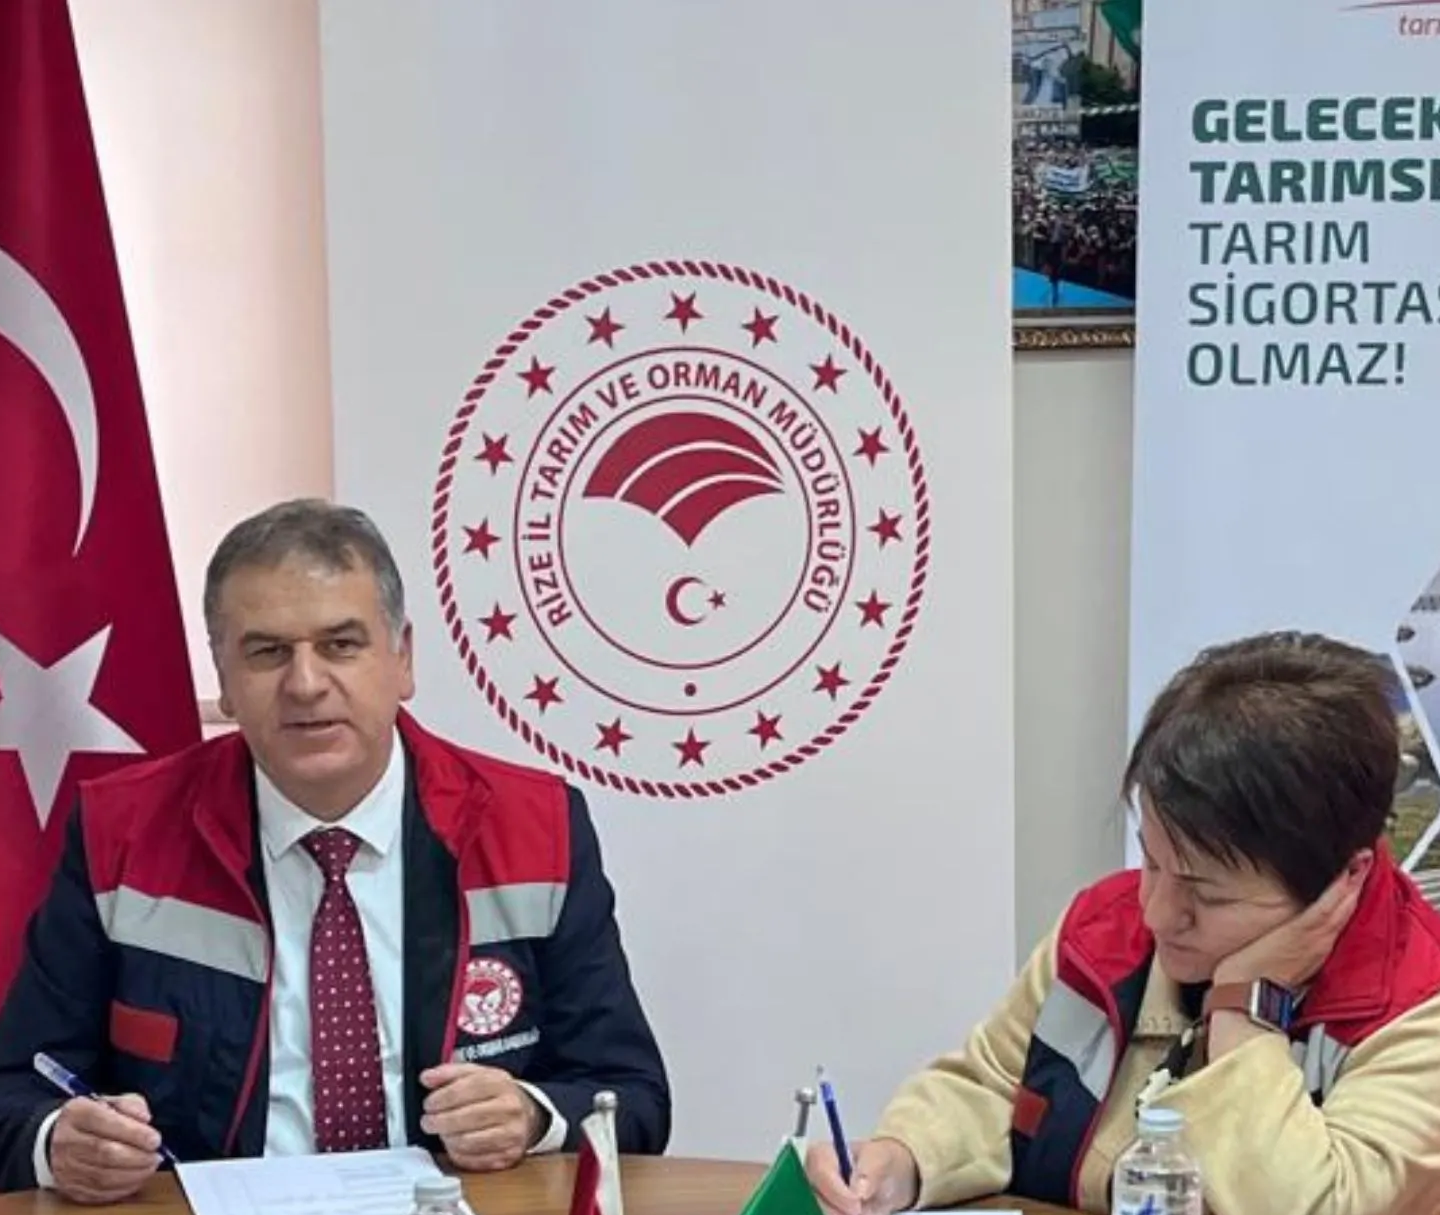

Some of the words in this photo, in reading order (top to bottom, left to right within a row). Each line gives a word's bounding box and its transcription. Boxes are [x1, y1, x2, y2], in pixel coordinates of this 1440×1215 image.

[1188, 220, 1370, 265] TARIM
[646, 360, 768, 409] ORMAN
[1186, 341, 1406, 386] OLMAZ!
[595, 372, 641, 410] VE
[530, 402, 600, 502] TARIM
[522, 512, 553, 541] İL
[767, 400, 847, 614] MÜDÜRLÜĞÜ
[529, 552, 573, 628] RİZE
